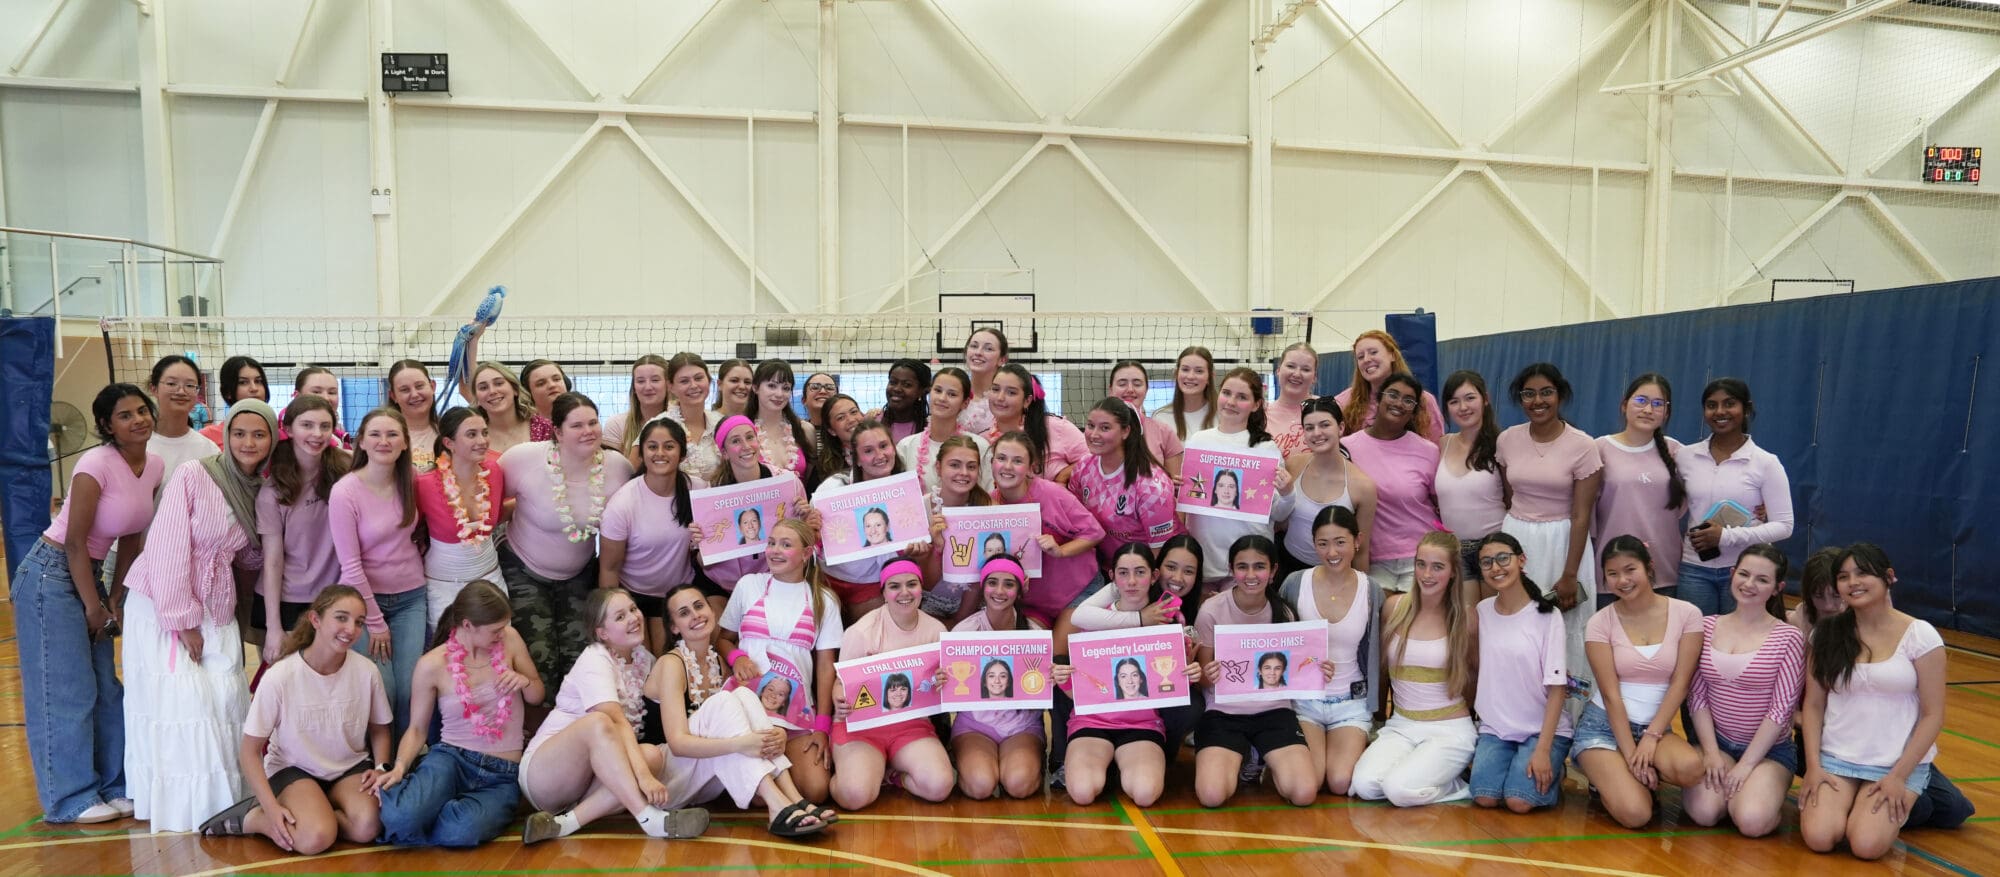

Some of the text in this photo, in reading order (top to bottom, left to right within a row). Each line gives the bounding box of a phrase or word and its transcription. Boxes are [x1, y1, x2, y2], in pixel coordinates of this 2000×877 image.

[1200, 453, 1261, 470] SUPERSTAR SKYE
[714, 489, 781, 511] SPEEDY SUMMER
[830, 487, 906, 512] BRILLIANT BIANCA
[958, 517, 1030, 530] ROCKSTAR ROSIE
[945, 643, 1048, 656] CHAMPION CHEYANNE
[1082, 640, 1173, 659] Legendary Lourdes
[1240, 635, 1305, 649] HEROIC HMSE
[862, 657, 925, 675] LETHAL LILIANA
